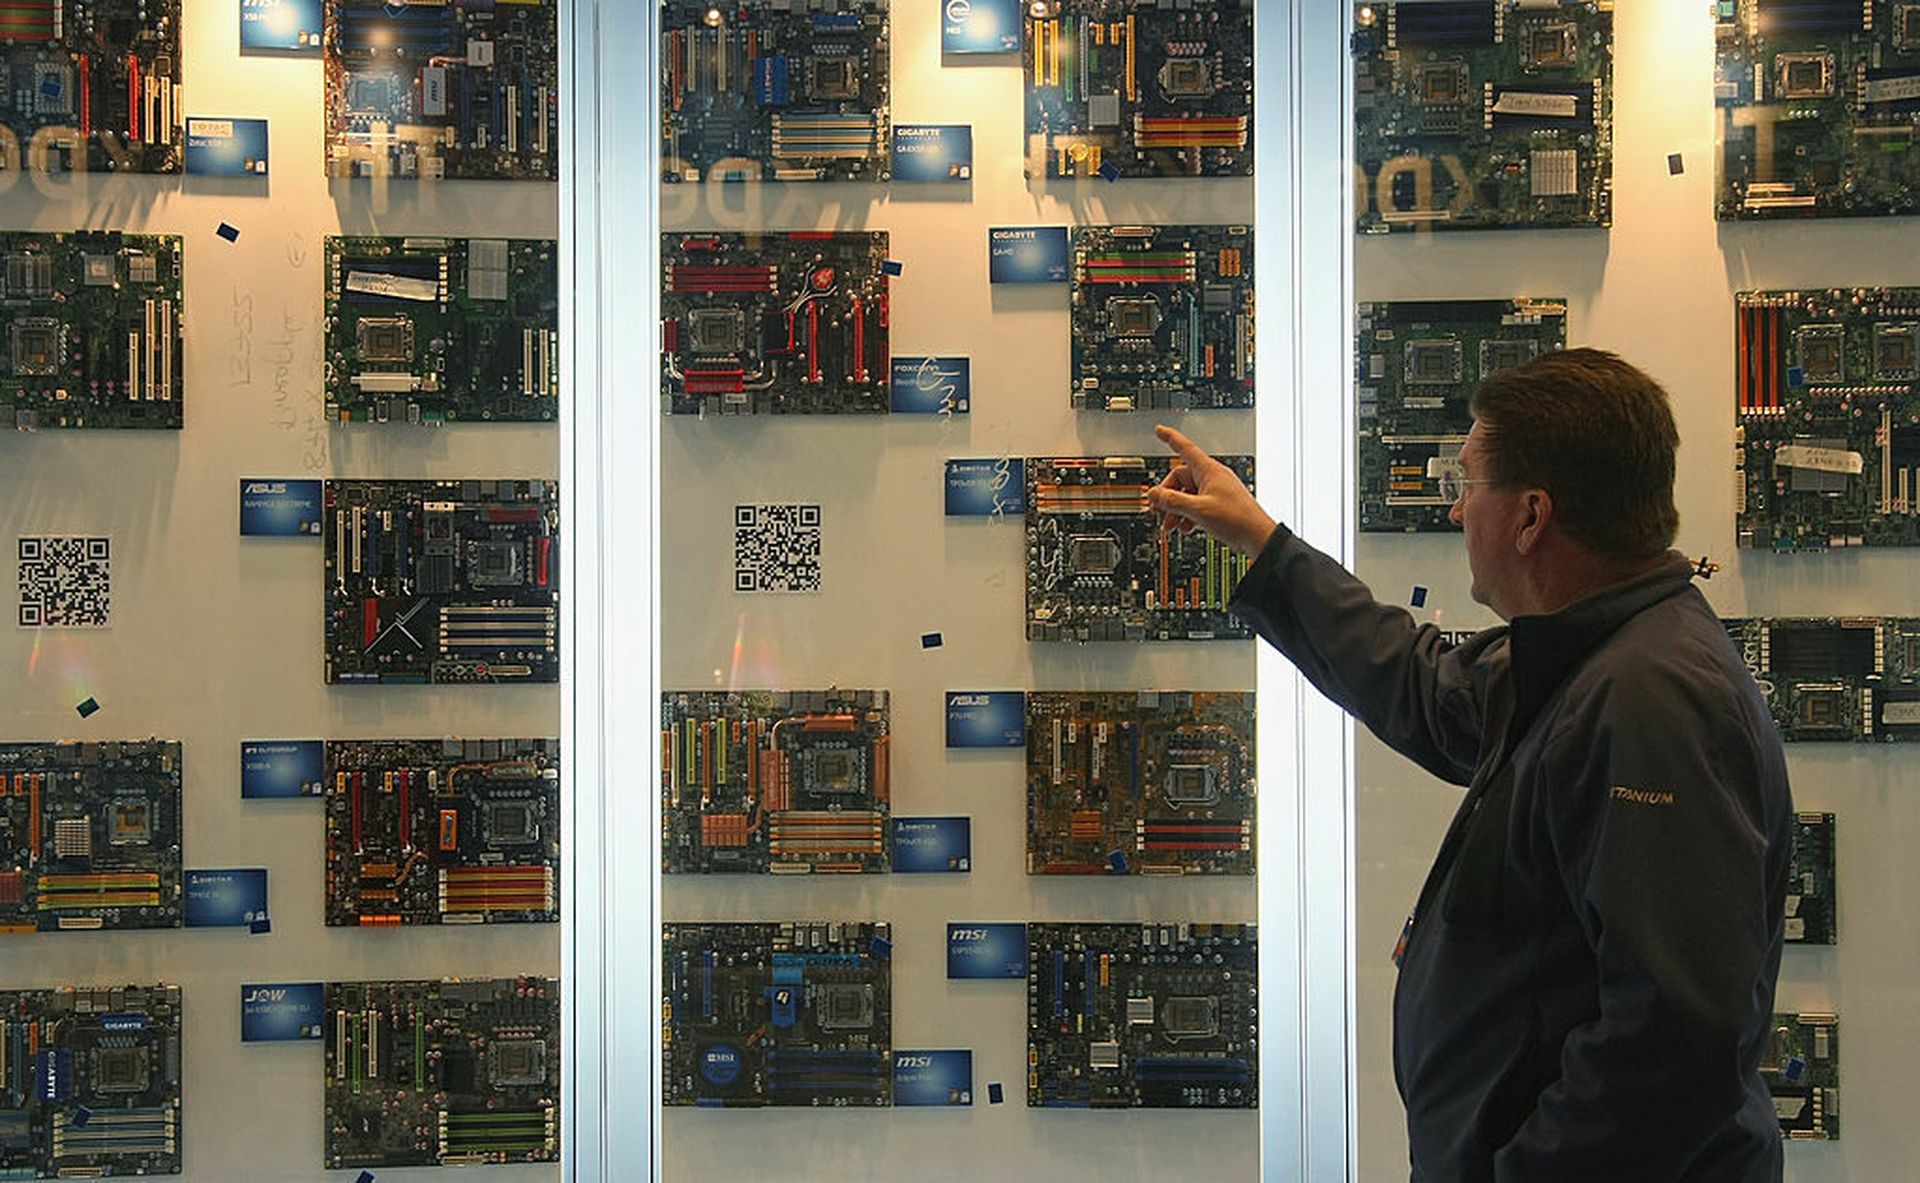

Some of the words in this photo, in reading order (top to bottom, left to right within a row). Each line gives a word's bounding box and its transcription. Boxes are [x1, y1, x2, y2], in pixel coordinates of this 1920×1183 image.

[897, 128, 940, 136] GIGABYTE
[993, 231, 1036, 239] GIGABYTE
[245, 483, 286, 494] ASUS
[950, 695, 990, 706] ASUS
[952, 929, 988, 940] msi
[104, 1022, 142, 1030] GIGABYTE
[896, 1056, 932, 1068] msi
[47, 1050, 56, 1099] GIGABYTE
